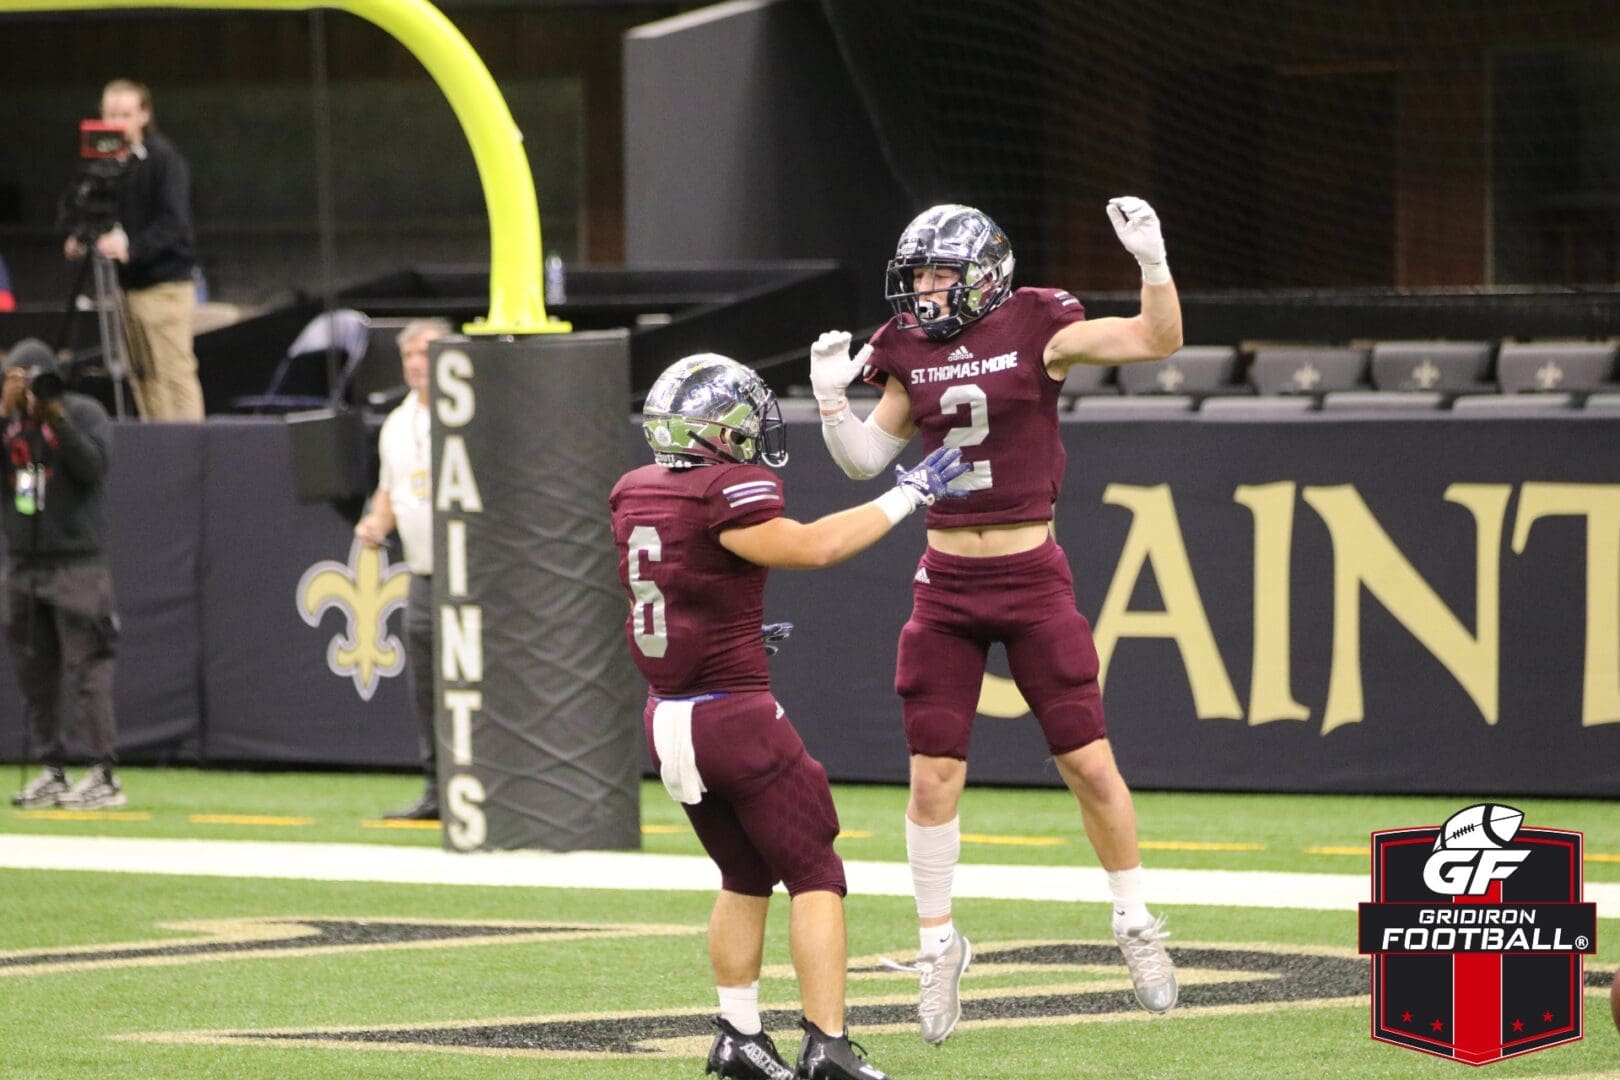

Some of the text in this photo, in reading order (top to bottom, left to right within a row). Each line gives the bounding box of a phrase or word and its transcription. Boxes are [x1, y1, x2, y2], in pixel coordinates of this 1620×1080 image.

[927, 361, 980, 383] THOMAS
[981, 351, 1018, 375] MORE
[947, 352, 974, 362] adidas
[939, 383, 993, 491] 2
[436, 350, 487, 851] SAINTS
[627, 526, 669, 658] 6
[976, 481, 1620, 736] AINT
